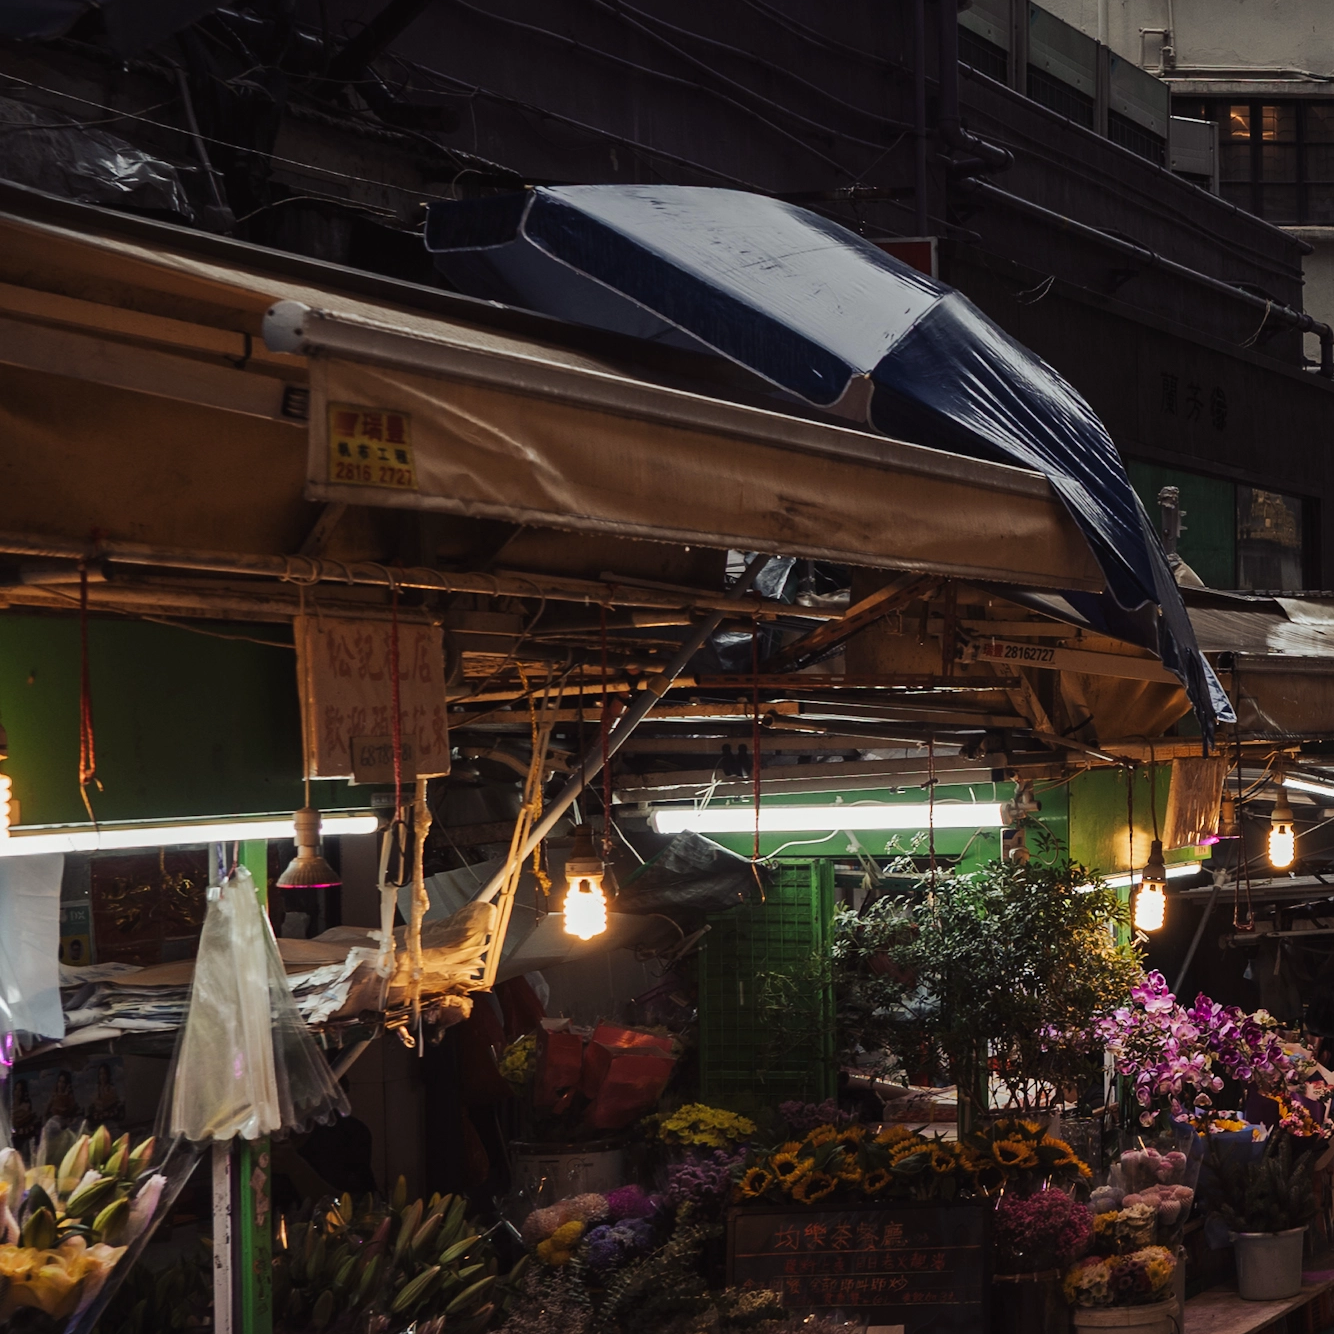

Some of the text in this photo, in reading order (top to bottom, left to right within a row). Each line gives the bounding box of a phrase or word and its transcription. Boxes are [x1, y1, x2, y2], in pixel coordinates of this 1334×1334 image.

[336, 462, 412, 485] 2816 2727
[1005, 645, 1055, 662] 28162727
